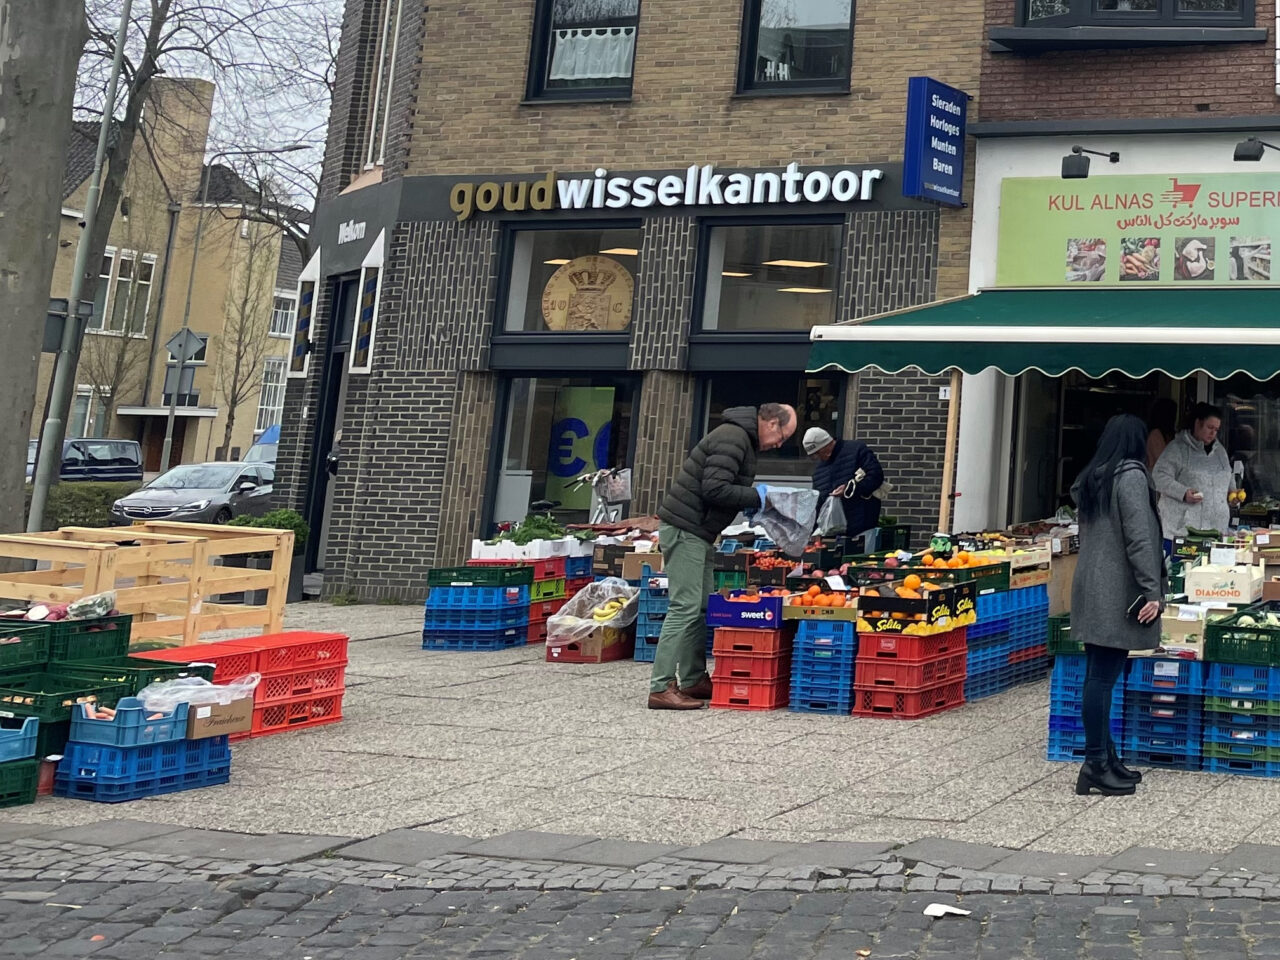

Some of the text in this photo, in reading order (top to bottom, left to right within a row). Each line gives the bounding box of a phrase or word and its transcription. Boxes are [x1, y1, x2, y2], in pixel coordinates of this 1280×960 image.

[932, 94, 961, 116] Sieraden
[930, 114, 960, 137] Horloges
[931, 136, 957, 155] Munten
[932, 158, 953, 175] Baren
[449, 162, 882, 221] goudwisselkantoor
[1048, 195, 1084, 211] KUL
[1091, 193, 1154, 210] ALNAS
[1116, 214, 1152, 230] الناس
[1154, 212, 1174, 230] كل
[1209, 216, 1240, 230] سوبر
[338, 220, 366, 245] Welkom
[1195, 589, 1241, 598] DIAMOND
[876, 619, 901, 632] Solita
